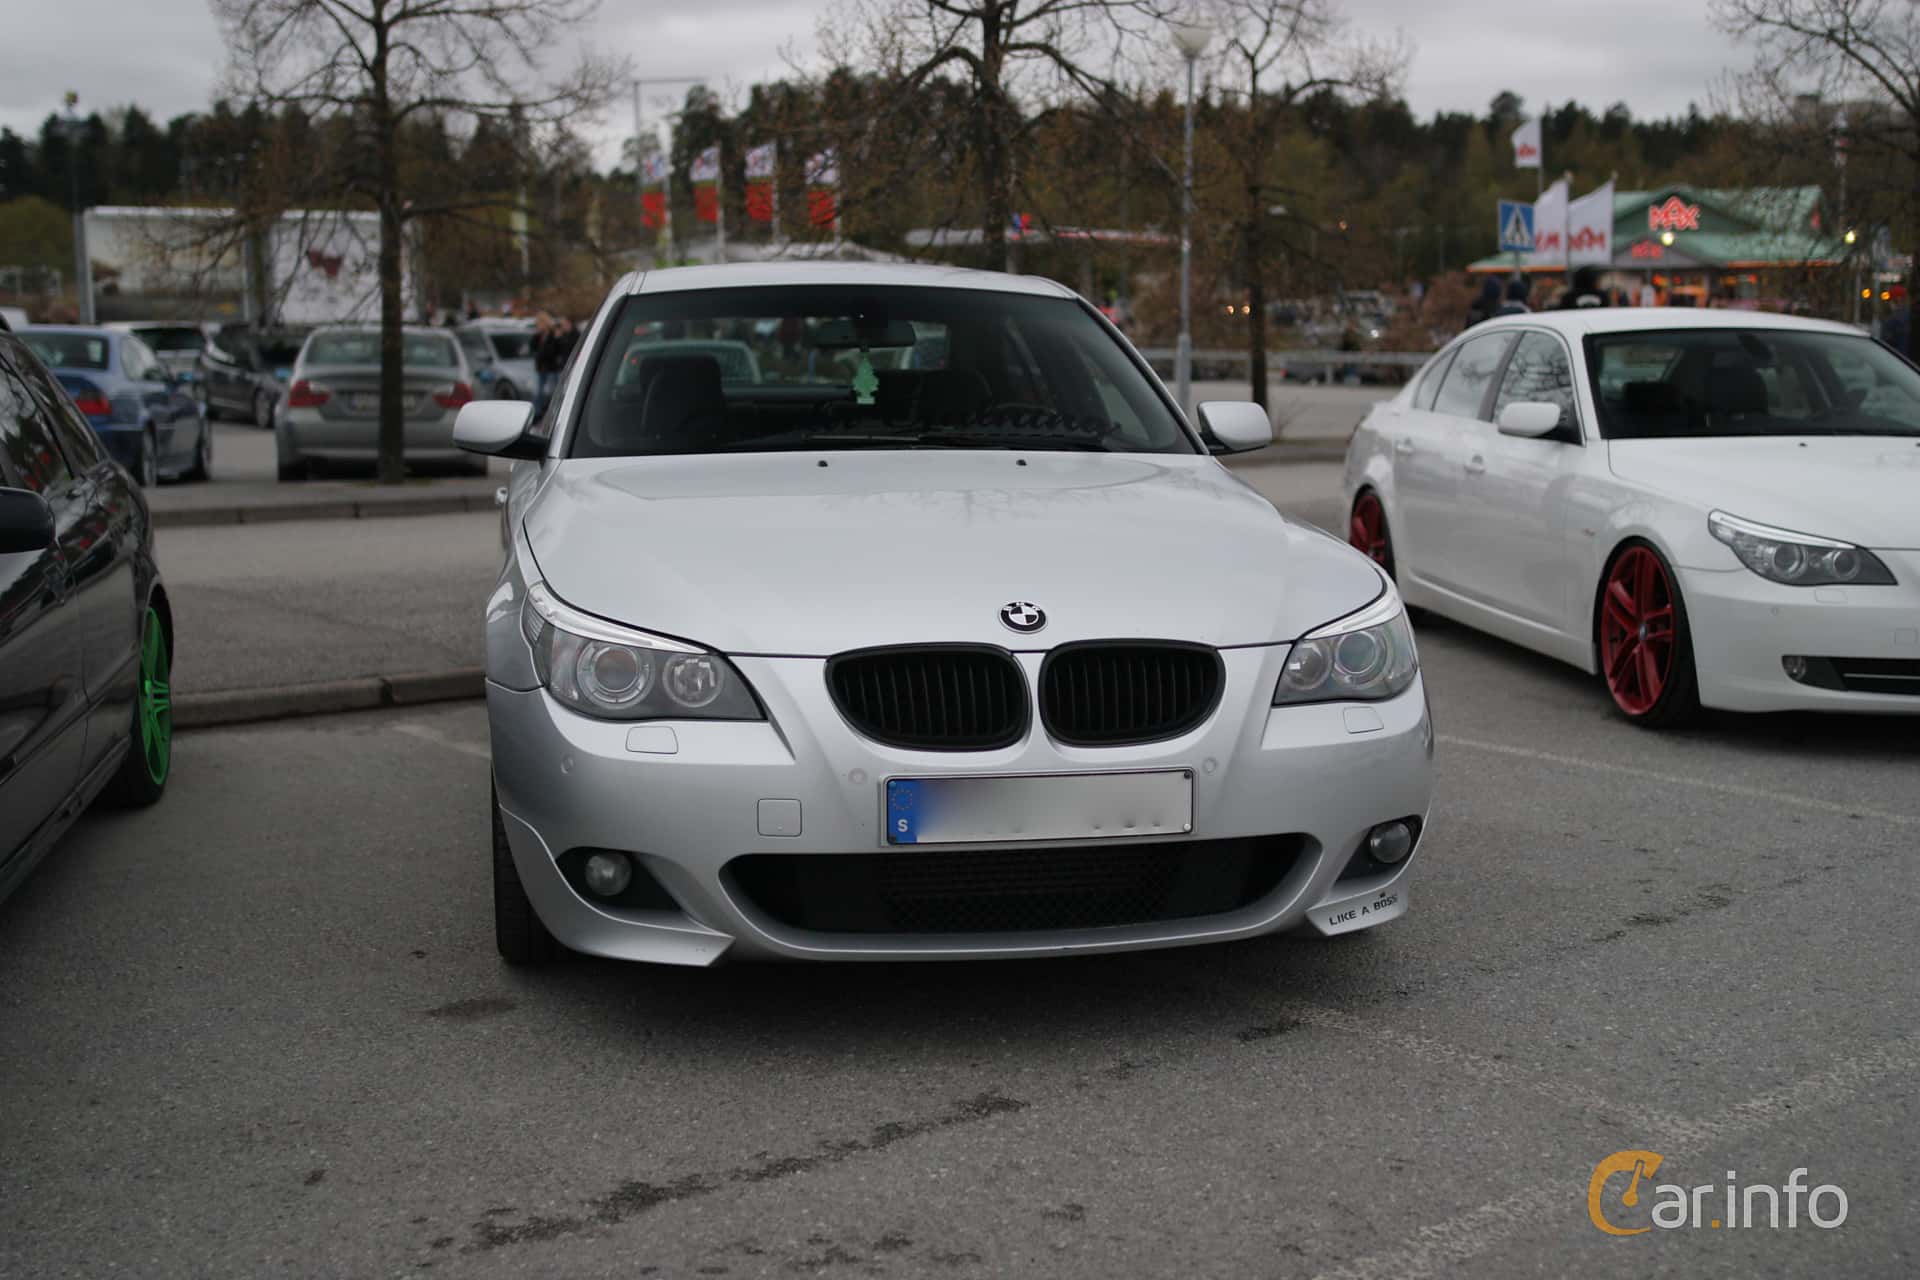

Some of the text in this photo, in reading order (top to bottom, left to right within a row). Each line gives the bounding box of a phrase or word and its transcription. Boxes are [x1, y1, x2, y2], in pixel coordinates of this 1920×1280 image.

[898, 818, 908, 832] S
[1329, 895, 1399, 926] LIKE A BOSS
